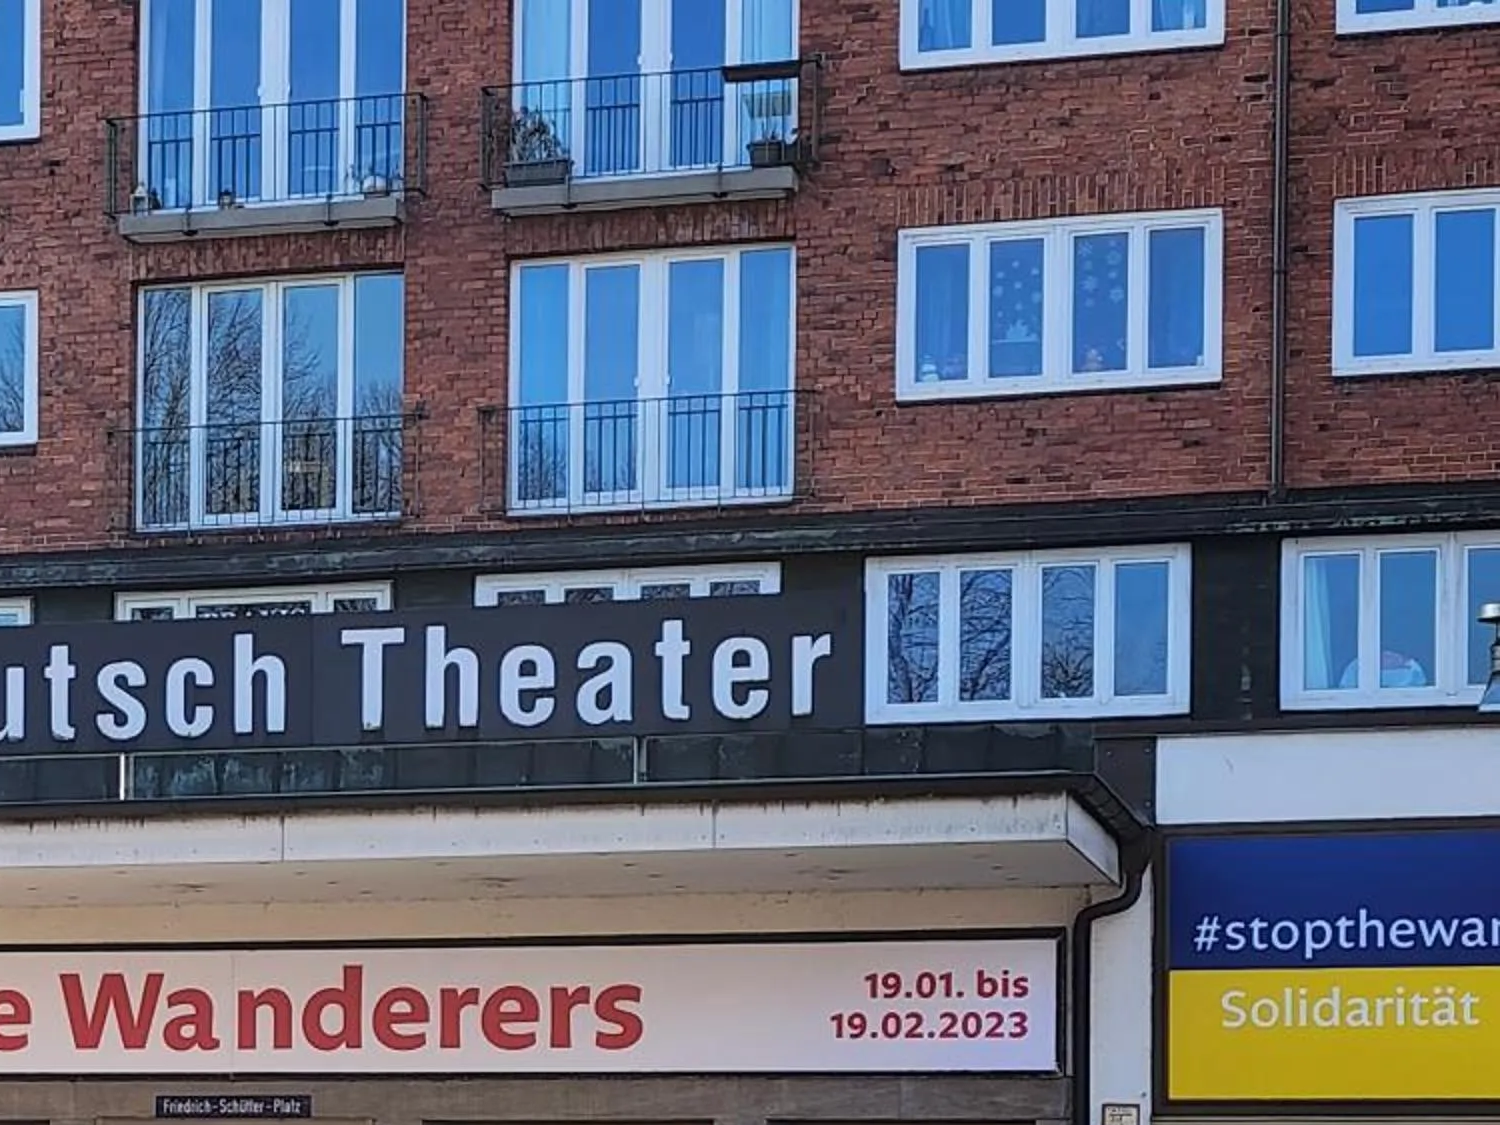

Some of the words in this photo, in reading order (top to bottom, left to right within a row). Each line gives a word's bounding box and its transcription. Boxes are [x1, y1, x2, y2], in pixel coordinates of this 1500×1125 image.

[340, 617, 832, 732] Theater
[863, 971, 966, 1000] 19.01.
[977, 969, 1030, 999] bis
[58, 964, 644, 1052] Wanderers
[829, 1010, 1030, 1040] 19.02.2023
[1220, 986, 1481, 1028] Solidarität
